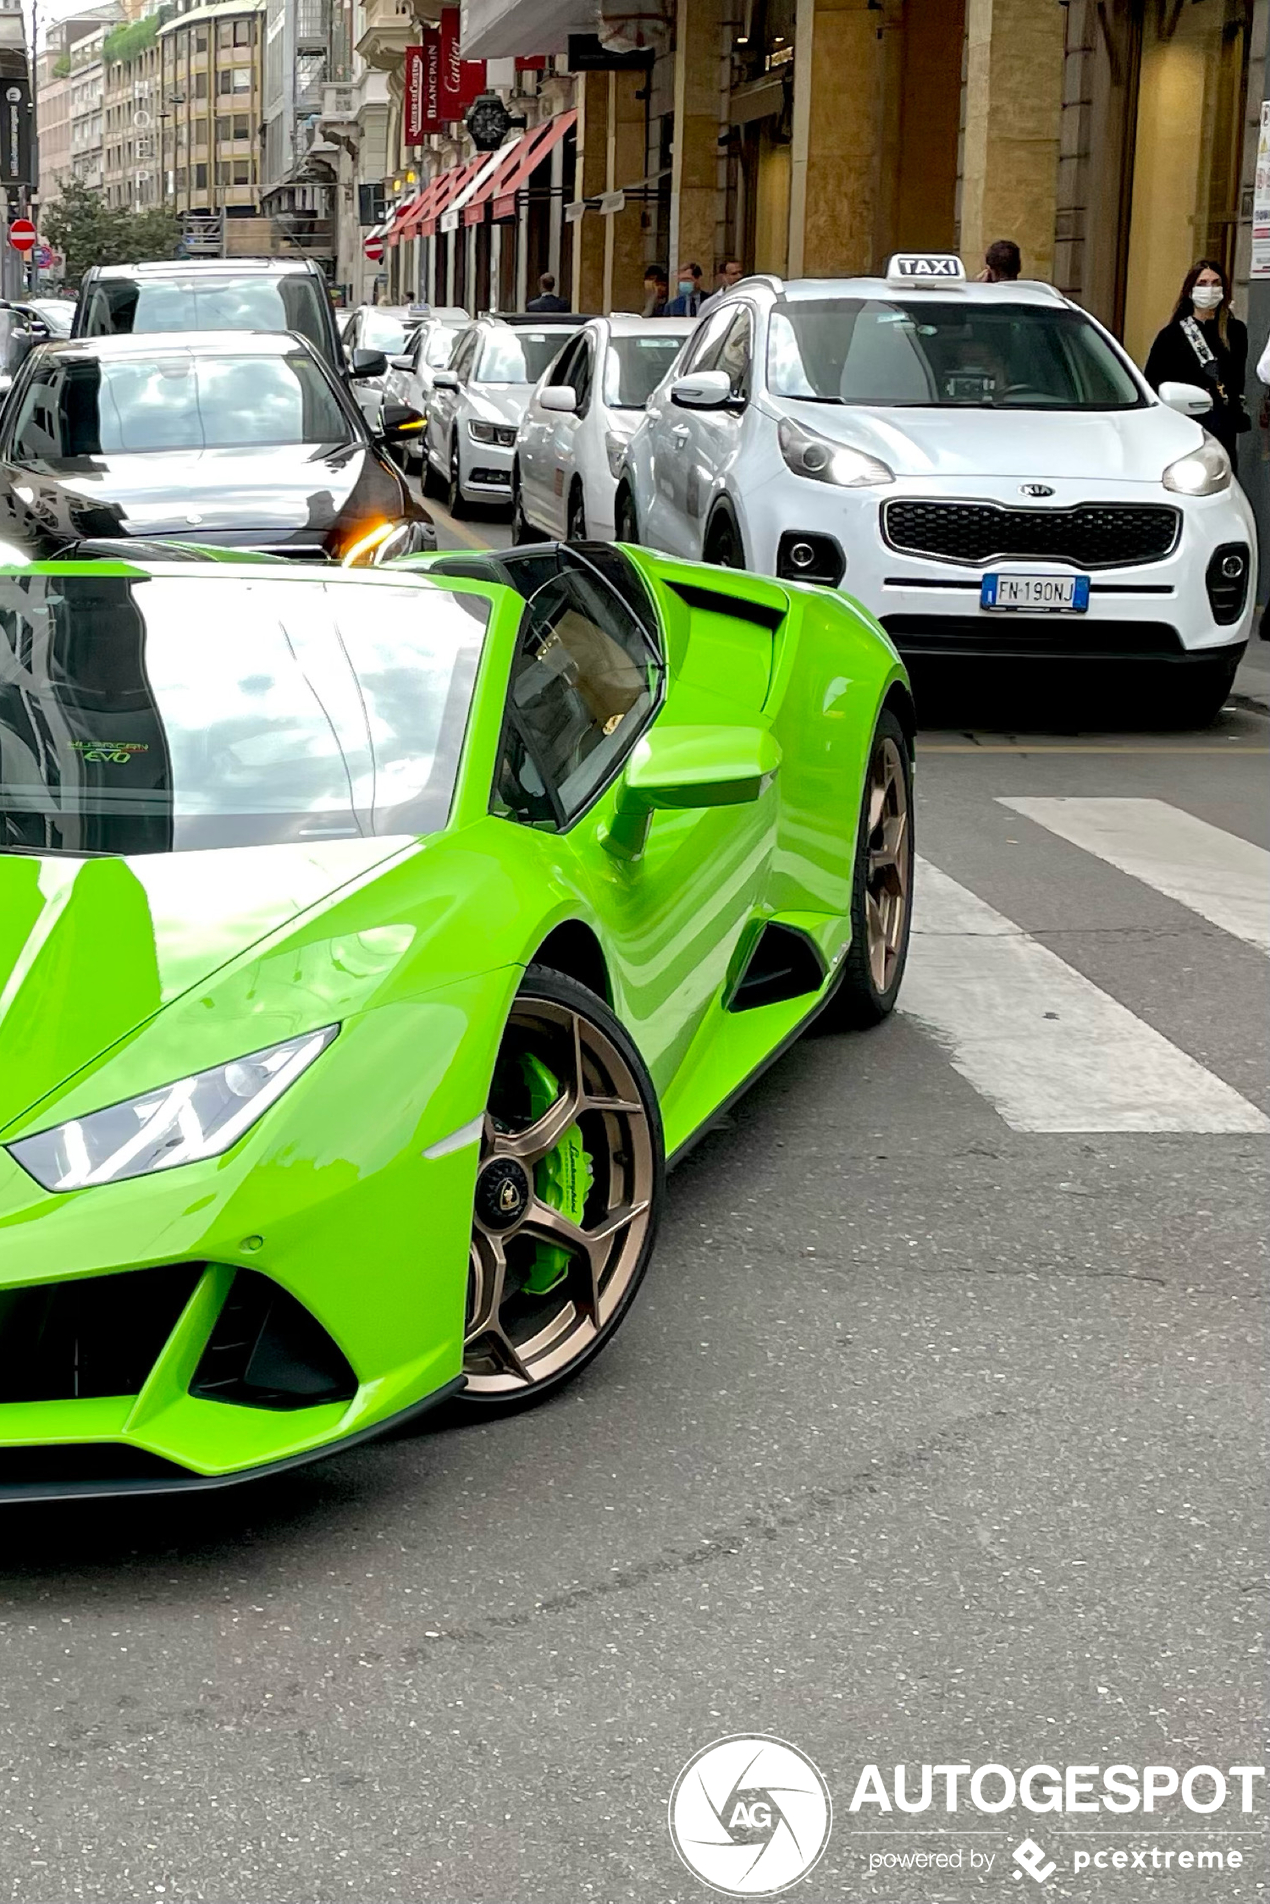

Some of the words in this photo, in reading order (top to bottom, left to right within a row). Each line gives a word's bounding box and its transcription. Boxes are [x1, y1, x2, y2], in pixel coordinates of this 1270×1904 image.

[427, 44, 437, 119] BLANCPAIN
[899, 260, 957, 274] TAXI
[1024, 484, 1051, 495] KIA
[84, 751, 131, 763] EVO
